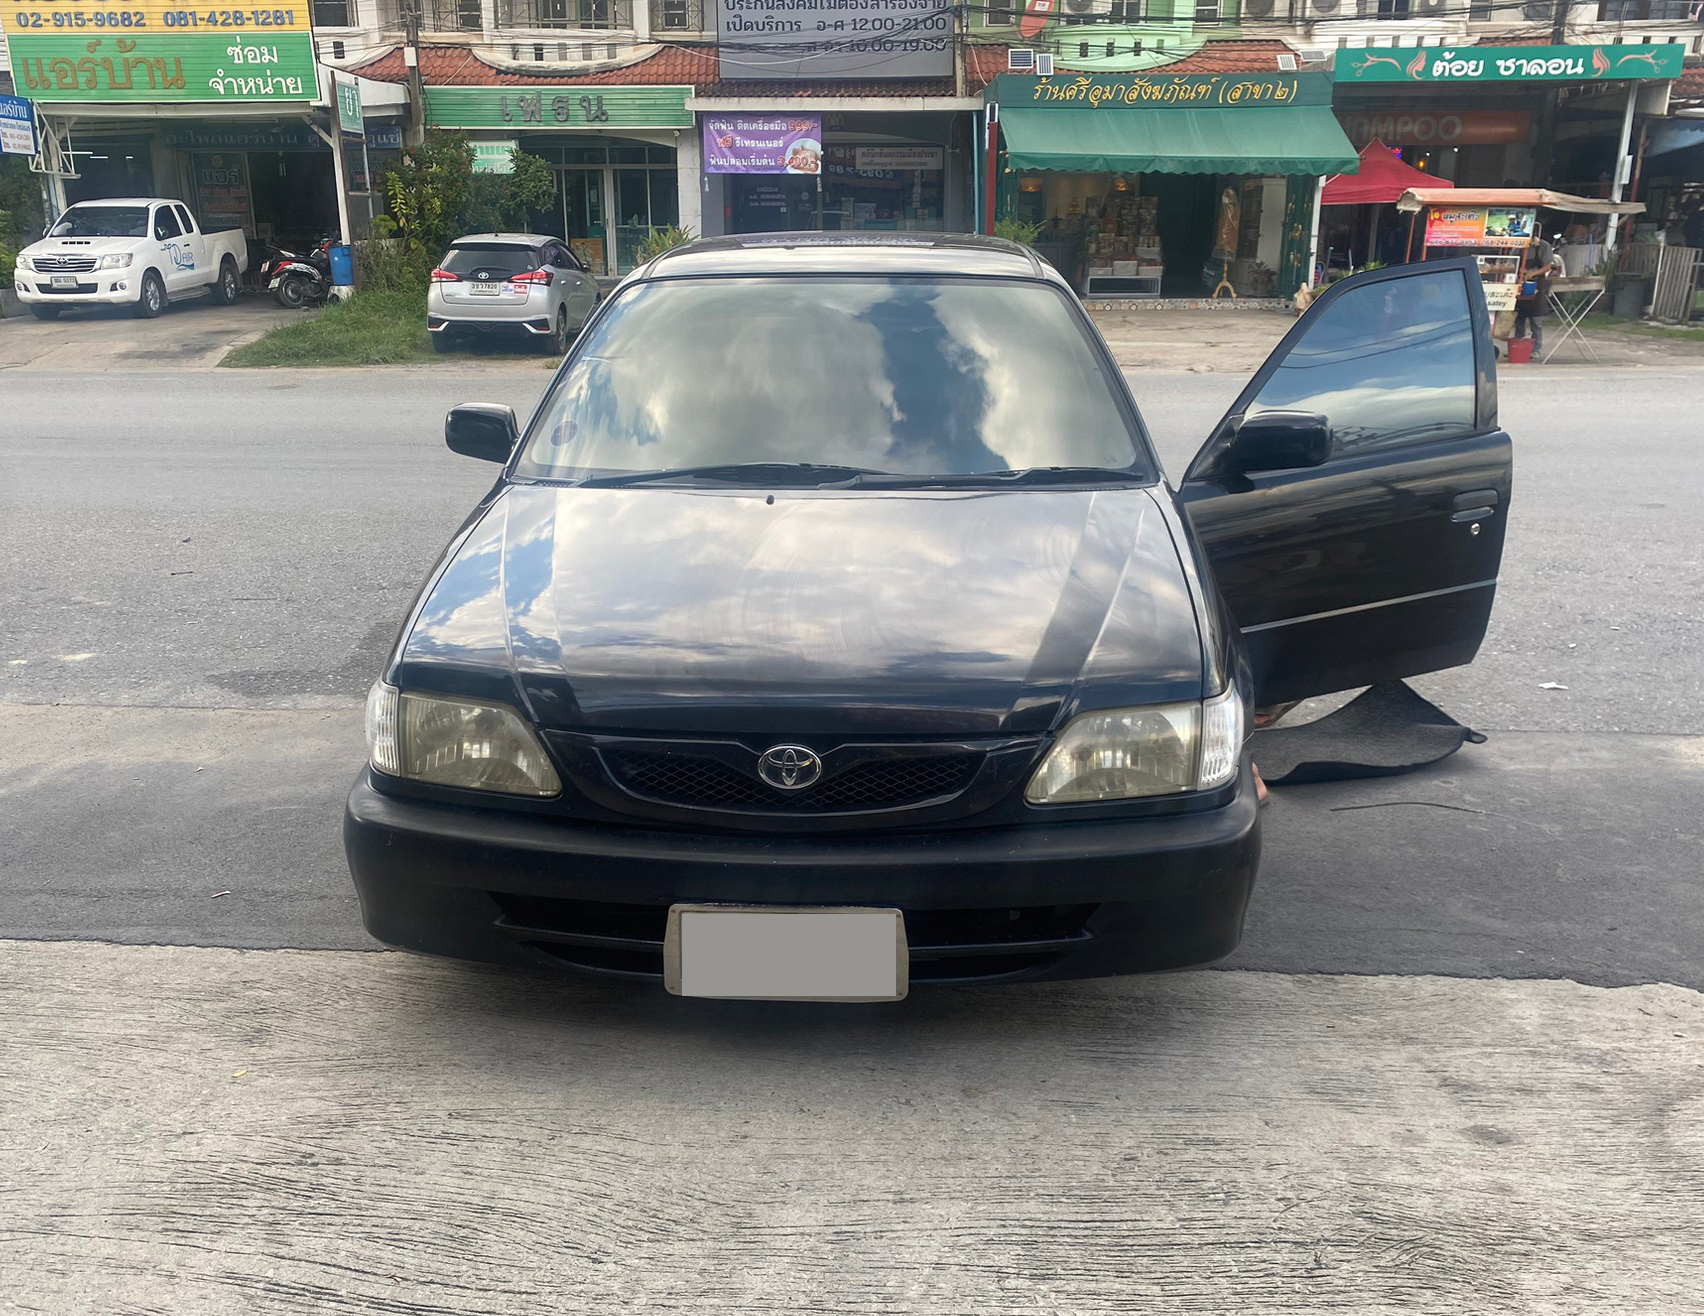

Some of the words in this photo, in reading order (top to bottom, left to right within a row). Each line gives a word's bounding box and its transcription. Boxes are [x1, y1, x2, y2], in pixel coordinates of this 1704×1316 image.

[16, 11, 146, 28] 02-915-9682
[163, 10, 294, 27] 081-428-1281
[727, 14, 802, 32] เปิดบริการ
[851, 18, 946, 31] 12.00-21.00
[227, 36, 279, 64] ซ่อม
[21, 38, 186, 90] แอร์บ้าน
[1433, 51, 1485, 77] ต้อย
[1496, 57, 1584, 75] ซาลอน
[209, 68, 303, 95] จำหน่าย
[1033, 77, 1219, 108] ร้านศรีอุมาสังฆภัณฑ์
[1218, 79, 1299, 104] (สาขา๒)
[344, 87, 360, 118] ยา
[708, 119, 734, 131] จัดฟัน
[709, 153, 776, 167] ฟันปลอมเริ่มต้น
